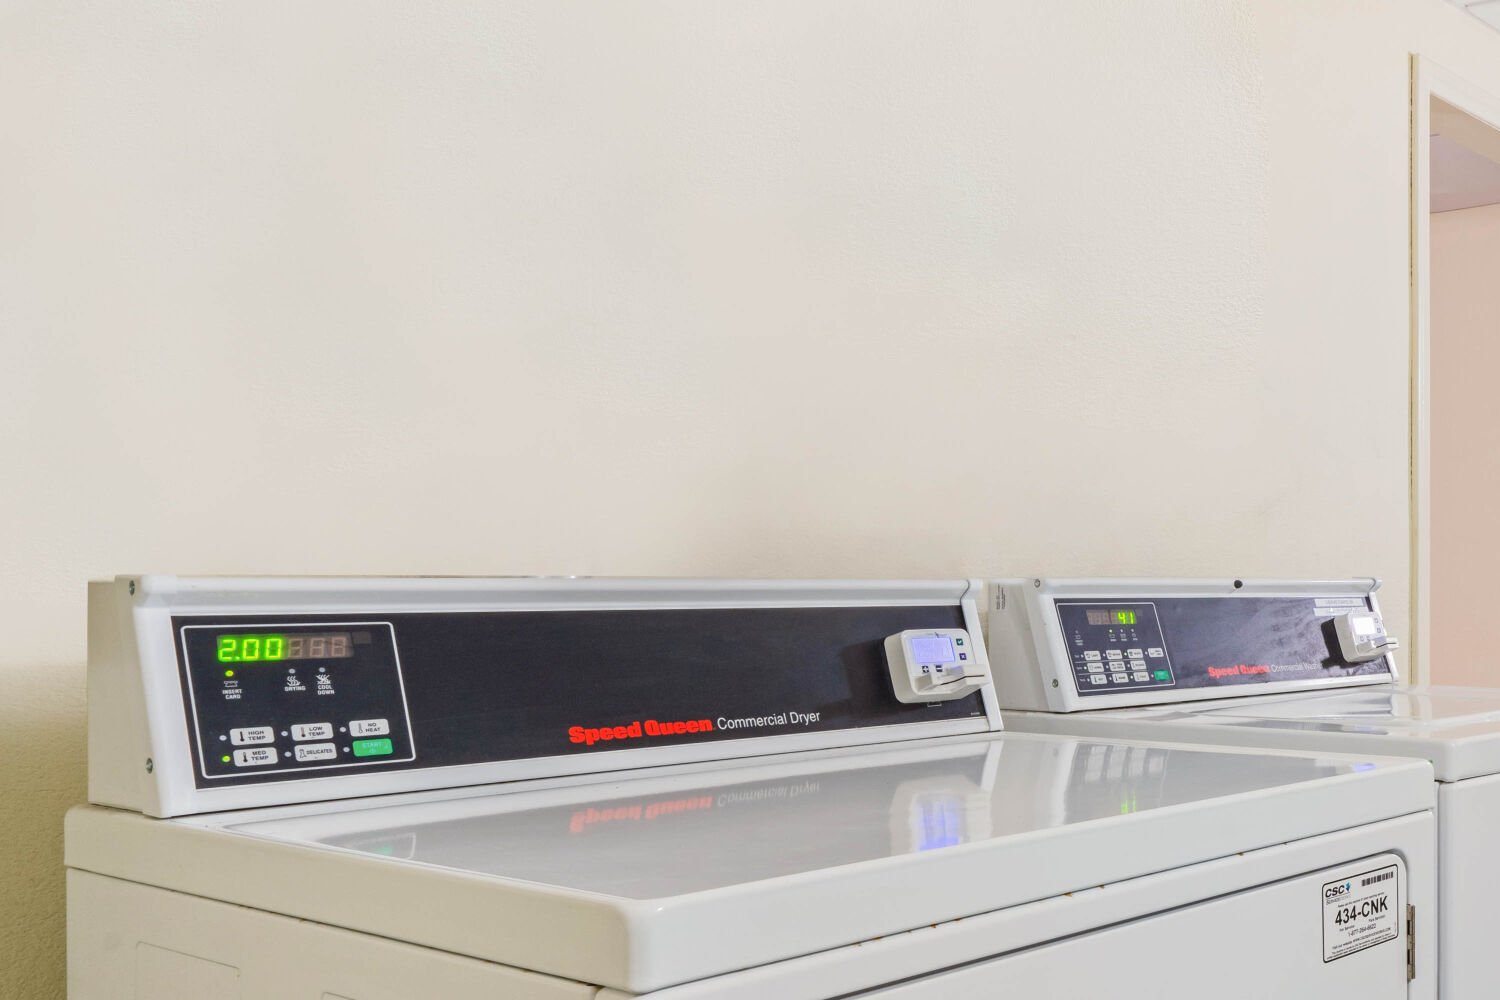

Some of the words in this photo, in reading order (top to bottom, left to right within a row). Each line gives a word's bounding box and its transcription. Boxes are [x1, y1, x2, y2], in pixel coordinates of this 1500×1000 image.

[1117, 611, 1135, 625] 41
[219, 638, 283, 660] 2.00
[1208, 664, 1239, 679] Speed
[568, 721, 642, 746] Speed
[644, 719, 713, 736] Queen
[717, 712, 788, 730] Commercial
[790, 711, 821, 727] Dryer
[1325, 884, 1345, 898] CSC
[1335, 895, 1388, 926] 434-CNK
